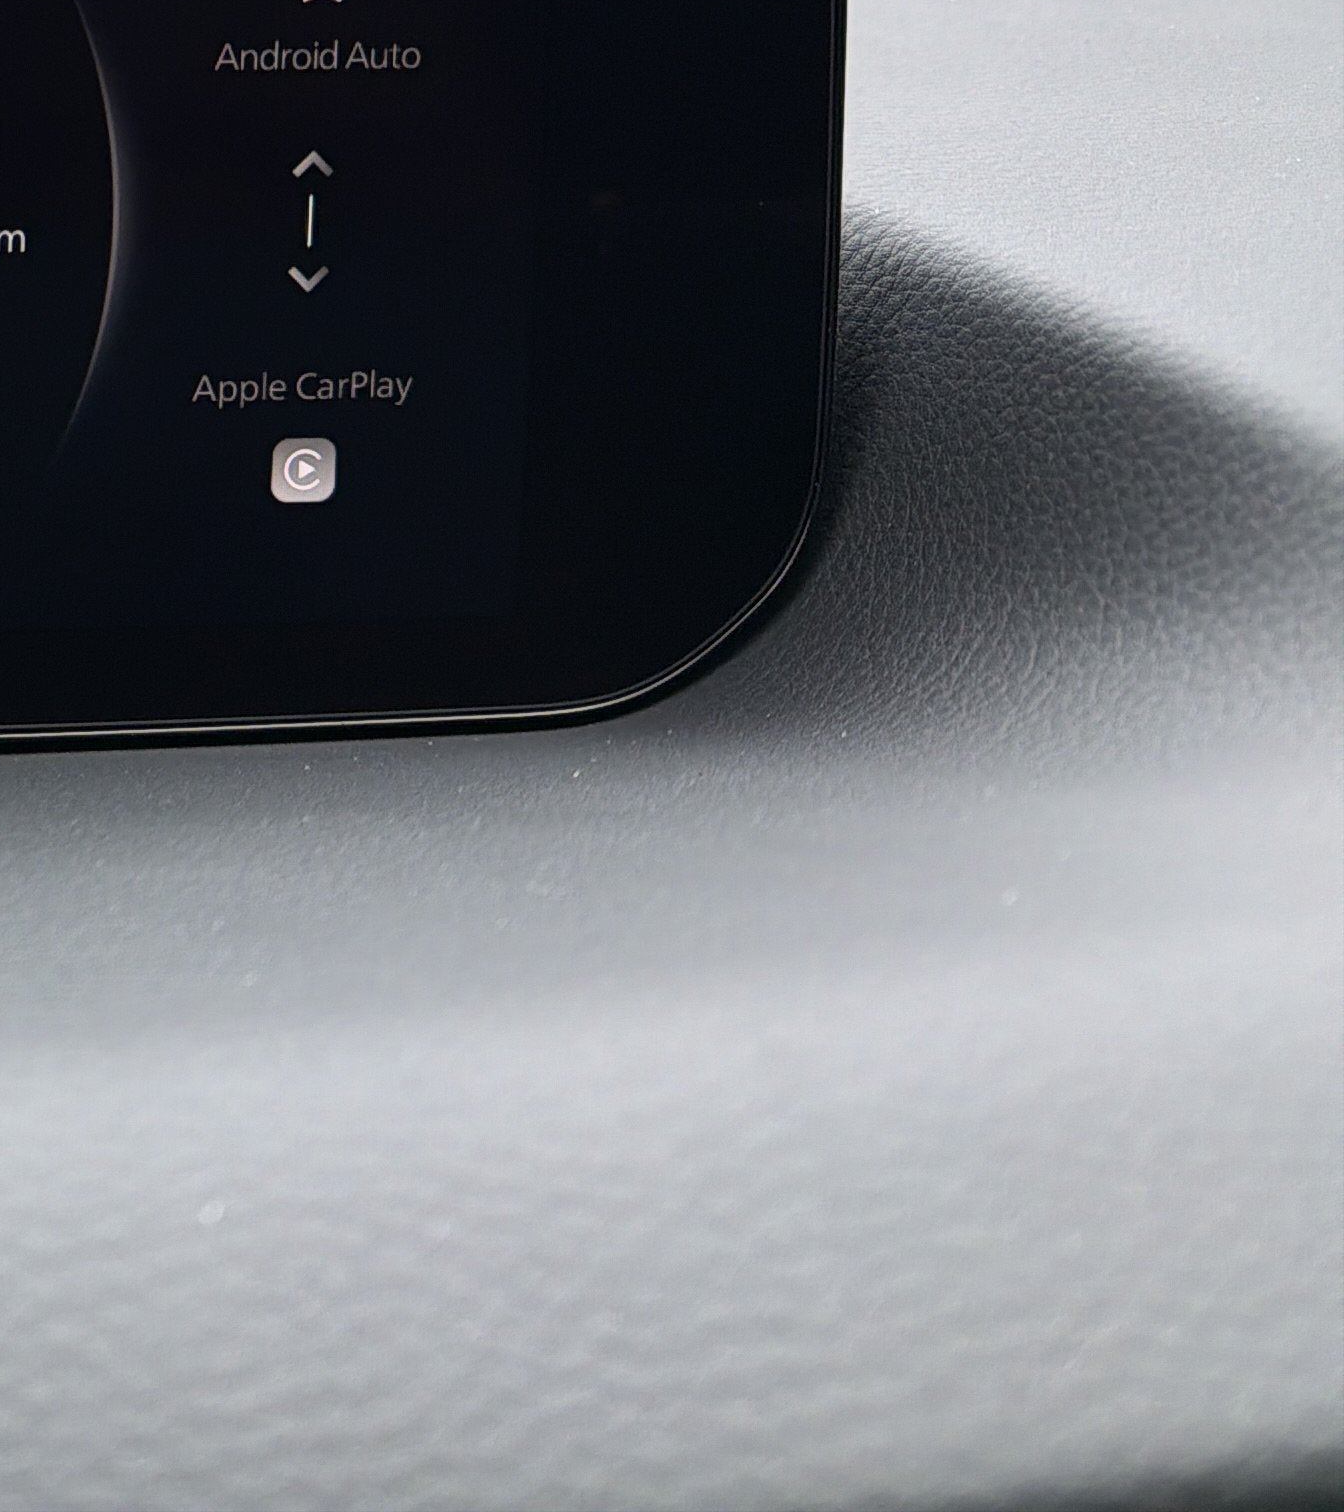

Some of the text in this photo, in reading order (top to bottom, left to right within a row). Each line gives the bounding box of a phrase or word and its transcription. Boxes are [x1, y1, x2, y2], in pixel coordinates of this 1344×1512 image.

[214, 39, 421, 71] Android Auto
[192, 369, 413, 409] Apple CarPlay
